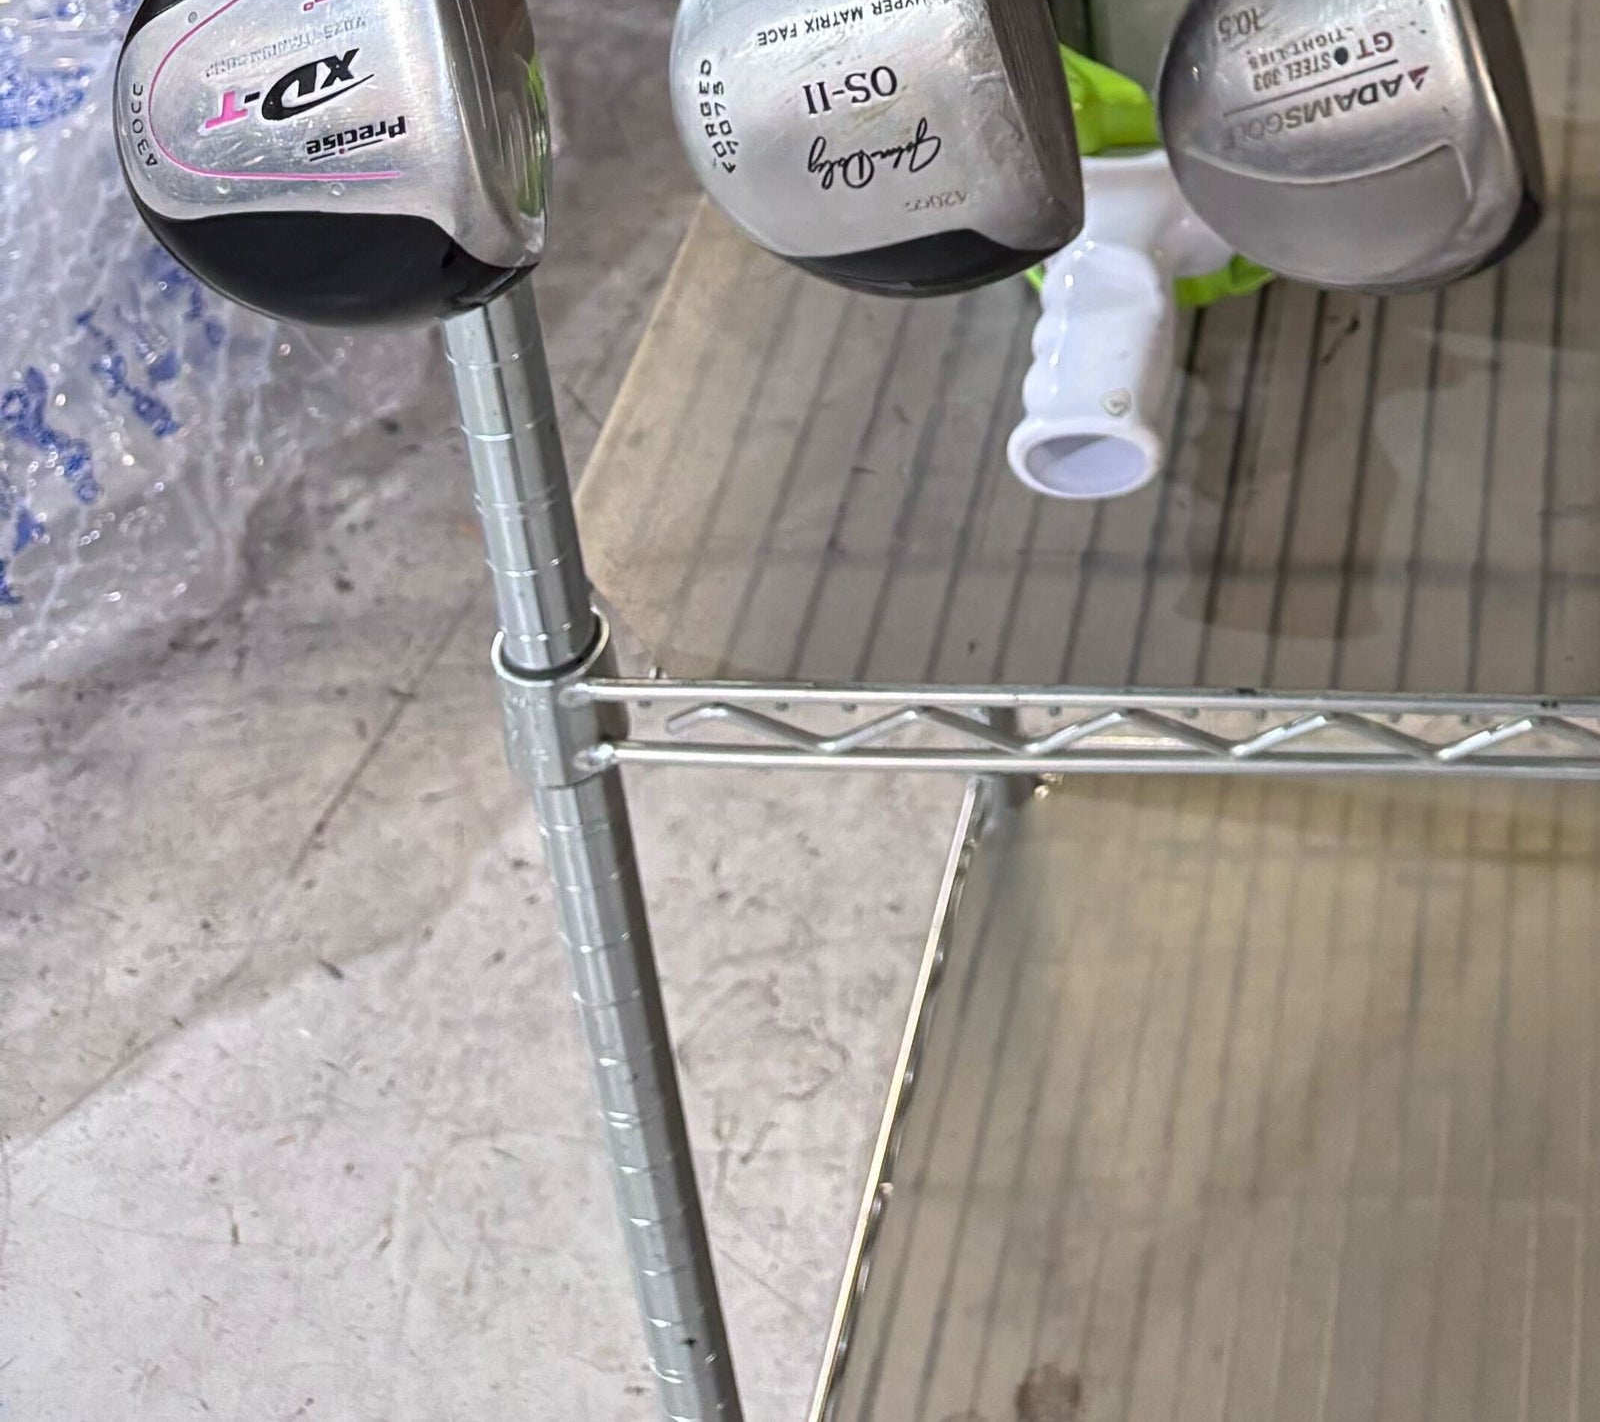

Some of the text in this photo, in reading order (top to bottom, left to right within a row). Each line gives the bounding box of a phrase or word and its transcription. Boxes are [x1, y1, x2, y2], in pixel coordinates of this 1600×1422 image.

[805, 6, 864, 32] MATRIX
[758, 22, 799, 47] FACE
[1357, 32, 1393, 59] GT
[1291, 52, 1332, 81] STEEL
[802, 65, 898, 117] OS-II
[699, 59, 737, 175] FORGED
[306, 115, 407, 157] Precise
